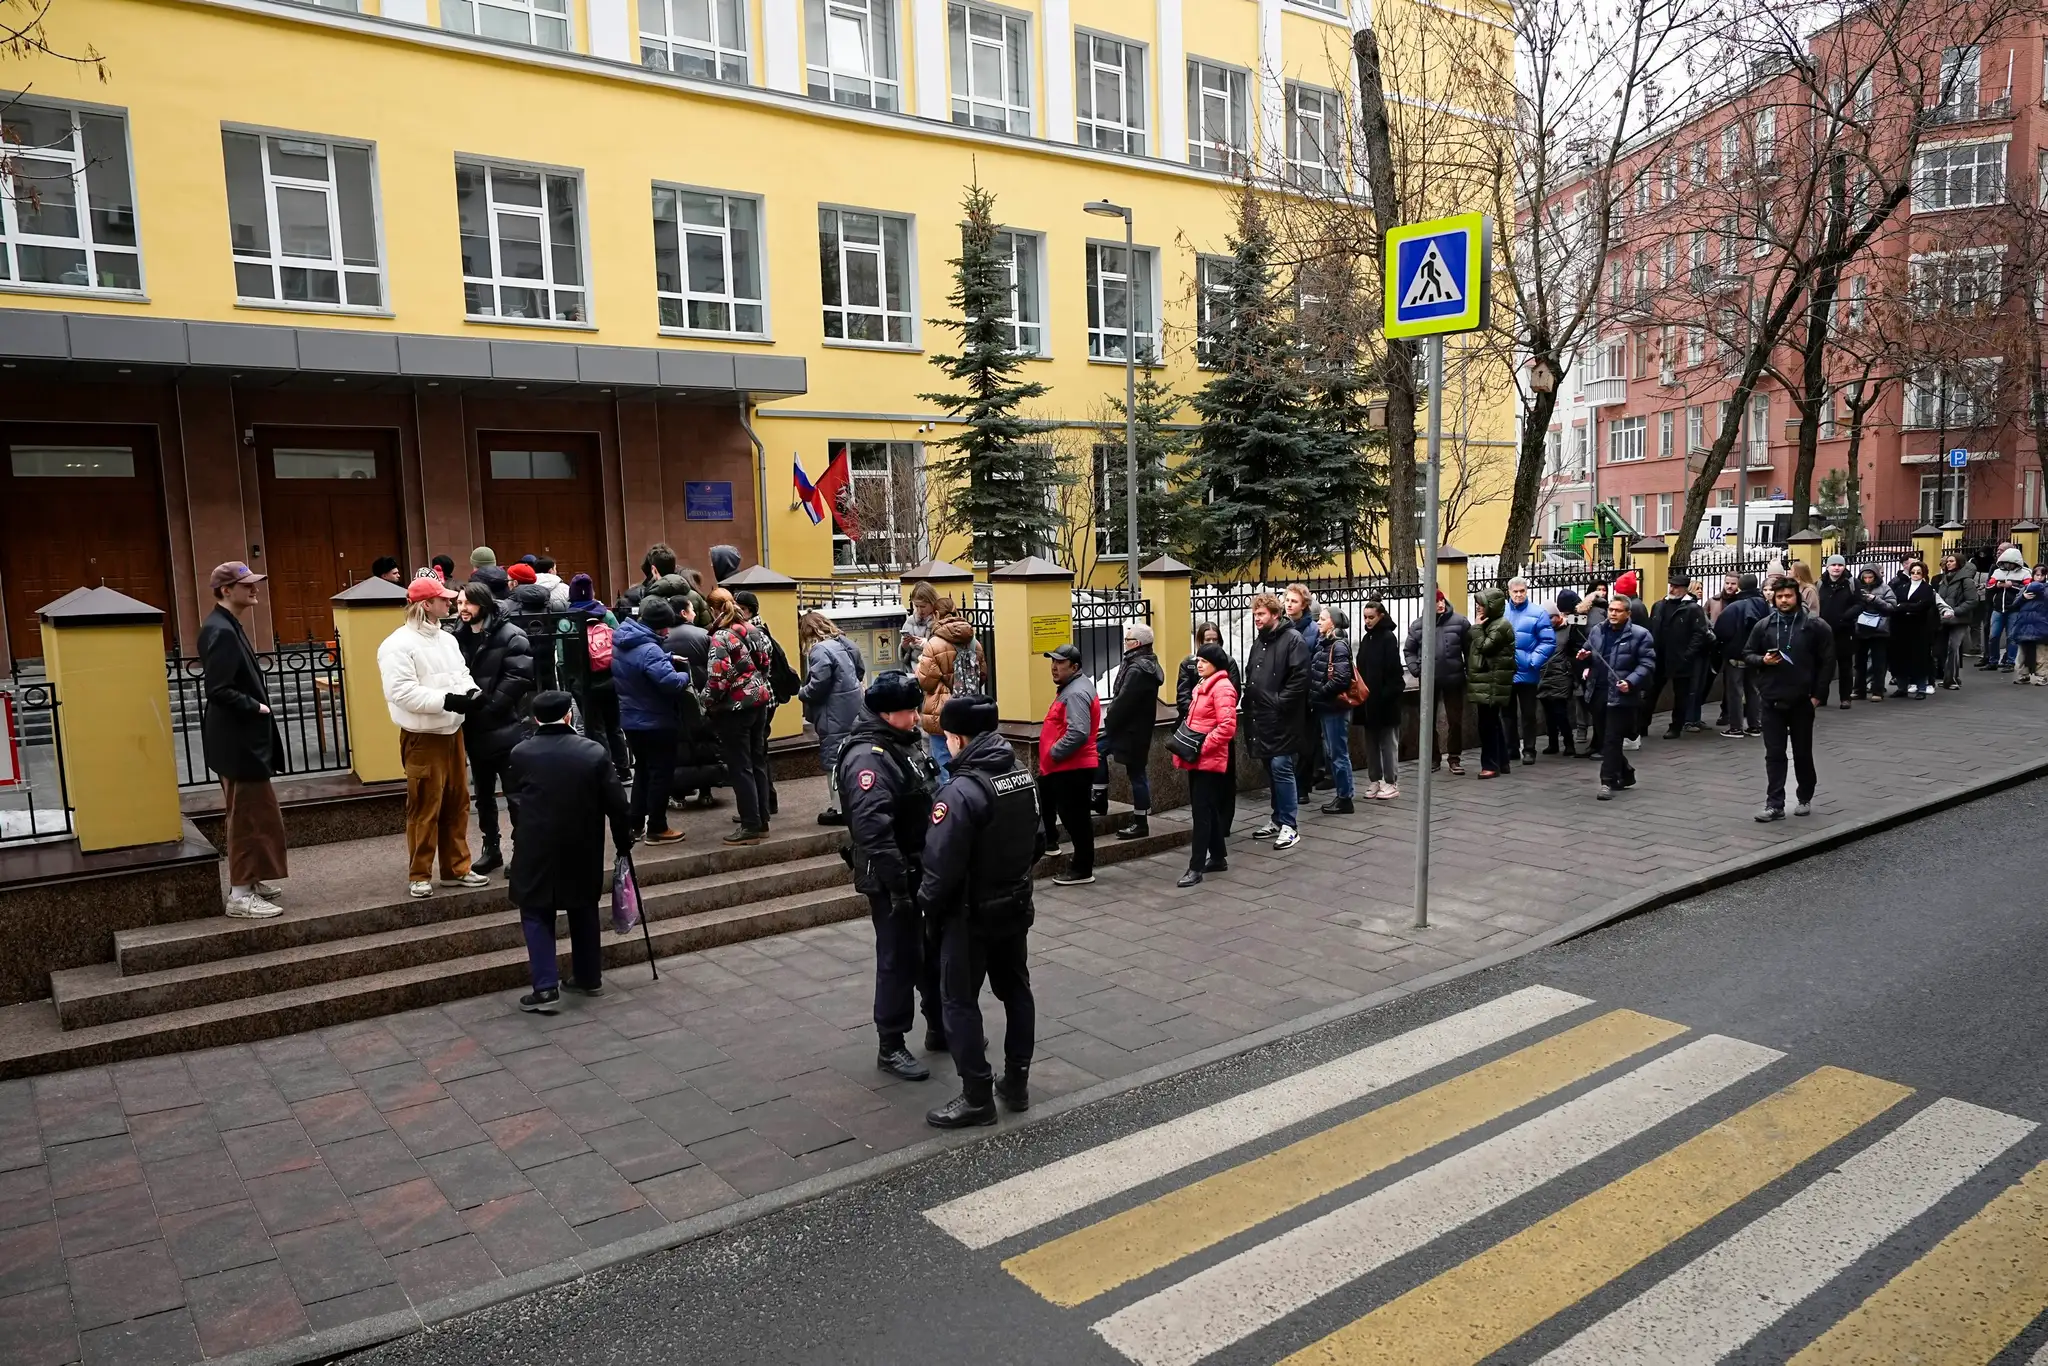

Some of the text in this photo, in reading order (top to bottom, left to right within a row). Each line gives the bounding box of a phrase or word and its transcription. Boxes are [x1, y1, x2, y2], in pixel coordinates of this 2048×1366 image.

[1709, 527, 1732, 540] 02-
[994, 773, 1033, 791] МВД РОССИИ
